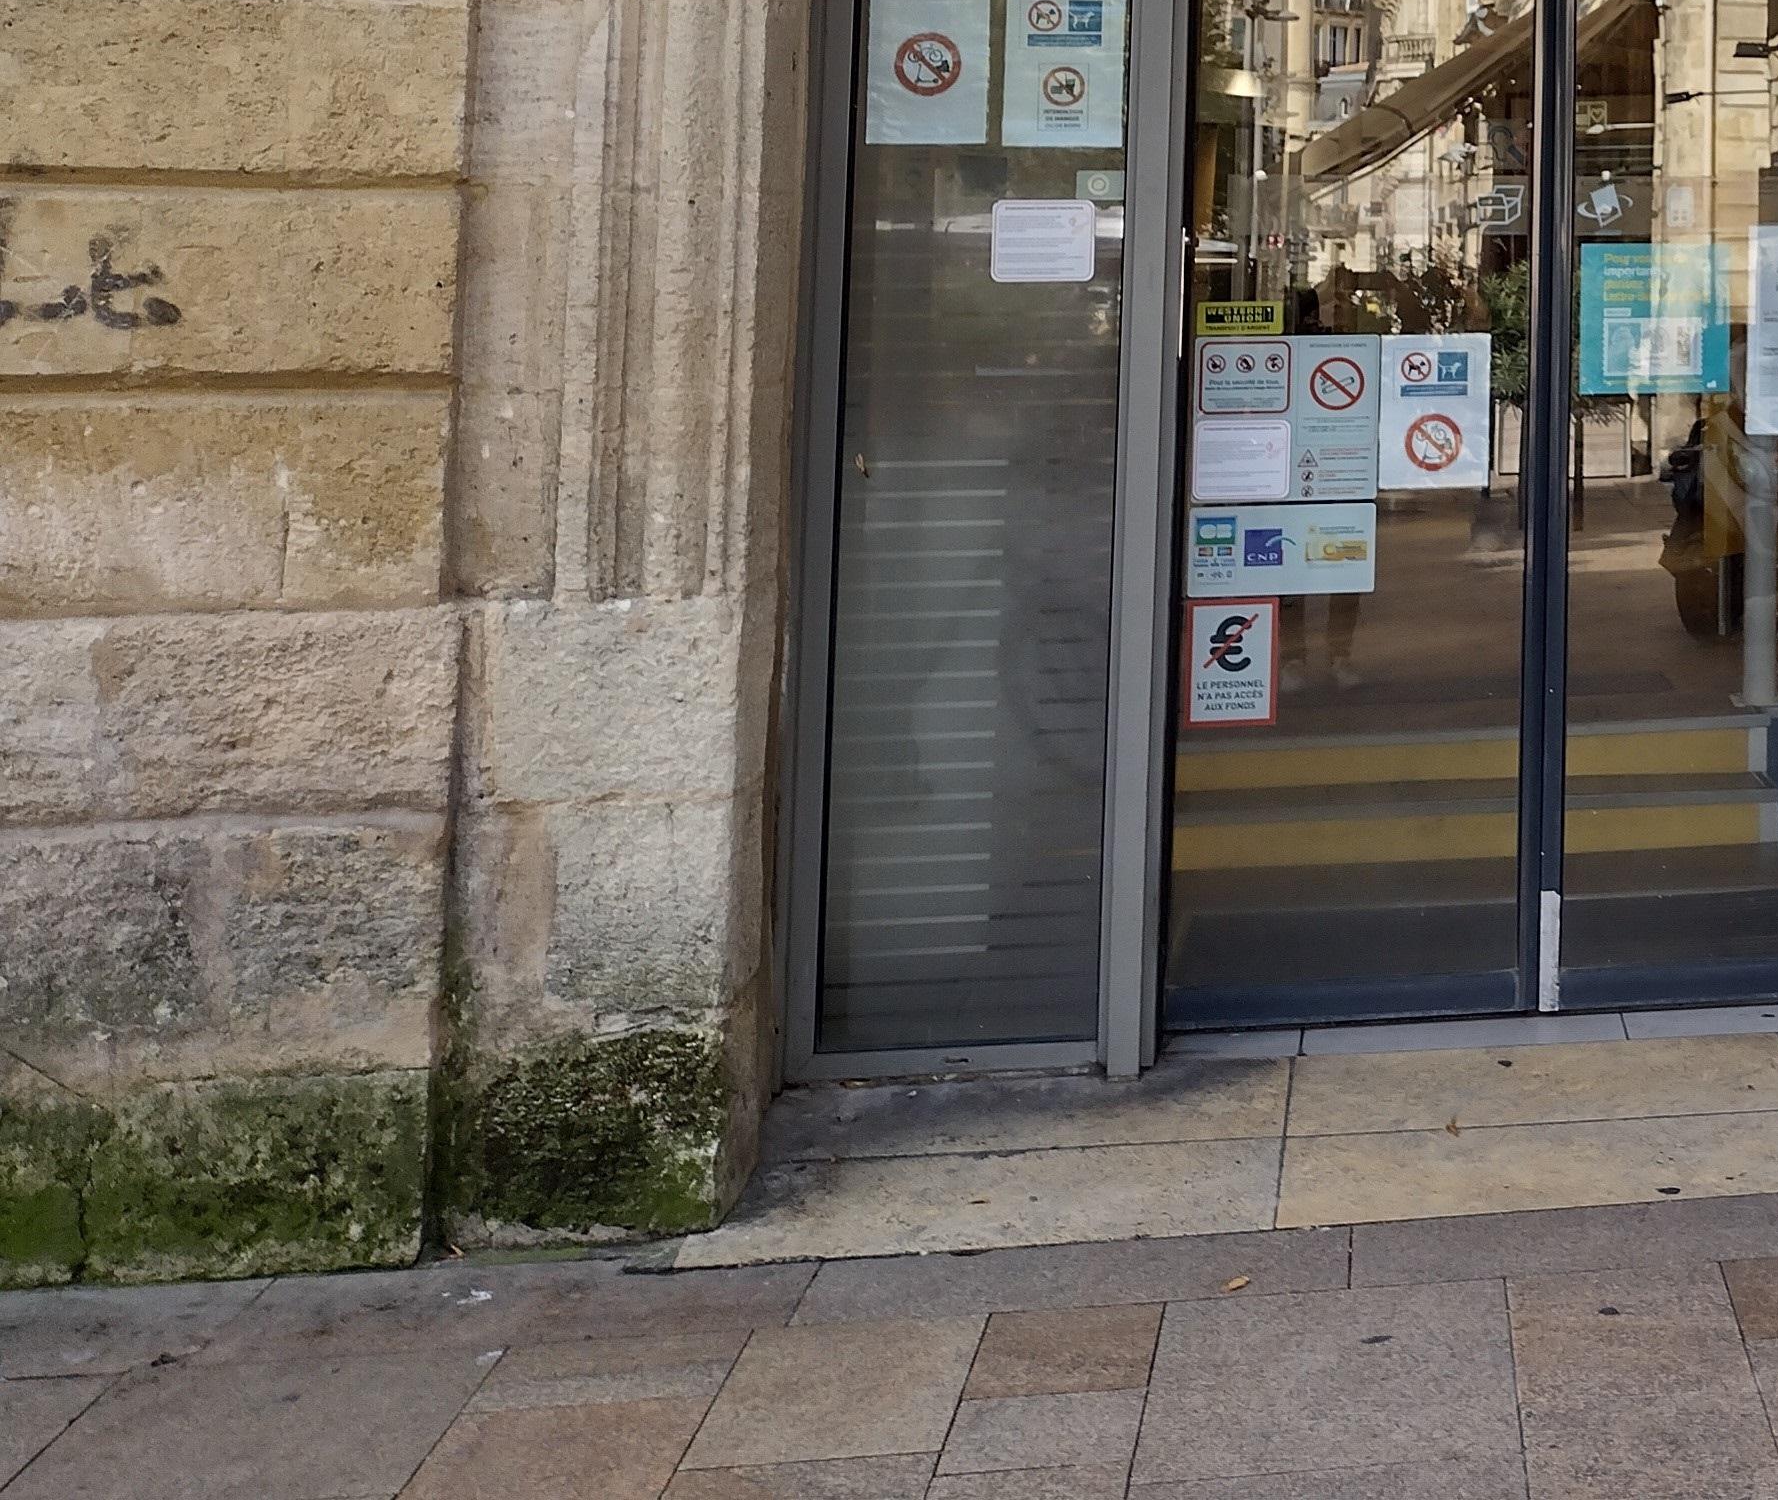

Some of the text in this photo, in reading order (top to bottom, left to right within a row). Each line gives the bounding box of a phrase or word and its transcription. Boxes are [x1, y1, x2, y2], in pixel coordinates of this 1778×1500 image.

[1207, 307, 1263, 315] WESTERN
[1223, 314, 1263, 323] UNION
[1199, 523, 1233, 539] CB
[1246, 551, 1279, 561] CNP
[1196, 679, 1264, 690] LE PERSONNEL
[1197, 691, 1213, 700] N'A
[1214, 691, 1232, 700] PAS
[1204, 701, 1256, 711] AUX FONDS
